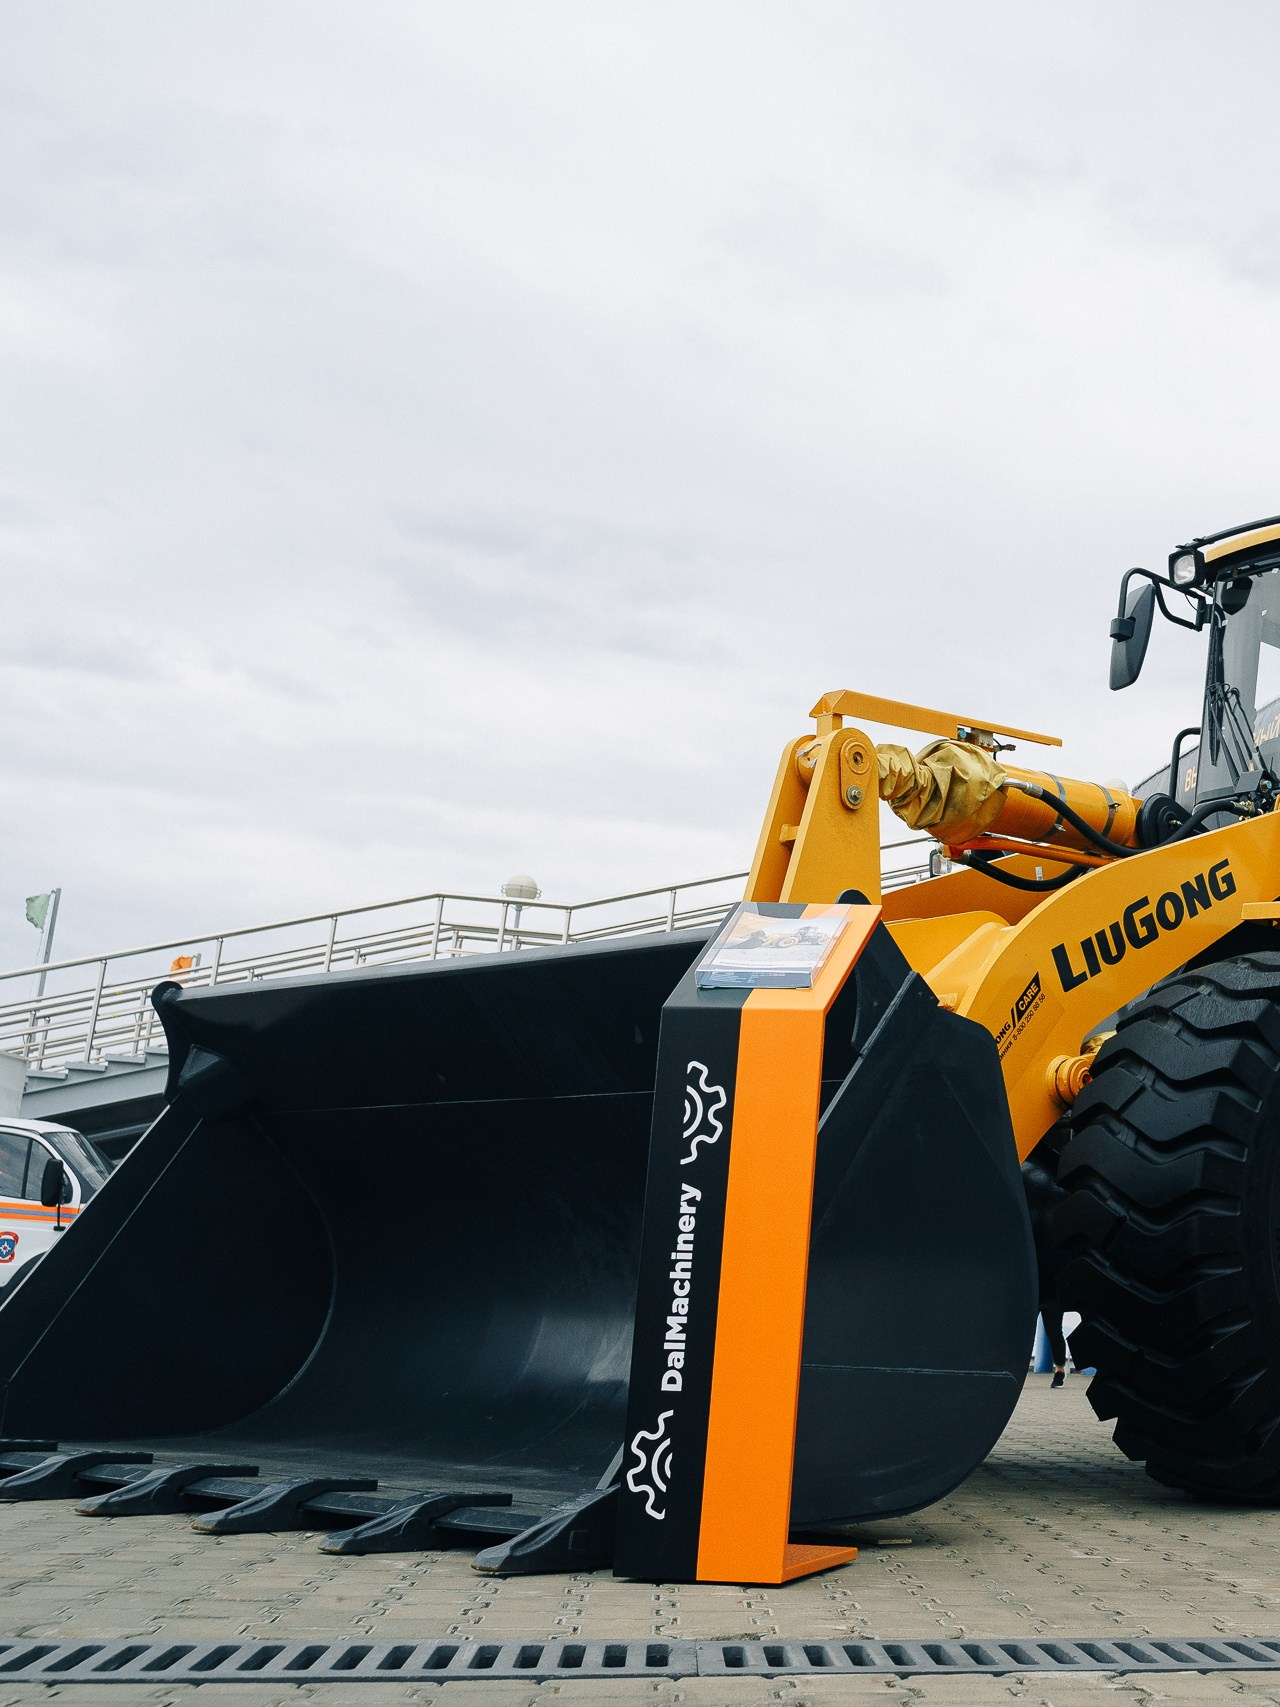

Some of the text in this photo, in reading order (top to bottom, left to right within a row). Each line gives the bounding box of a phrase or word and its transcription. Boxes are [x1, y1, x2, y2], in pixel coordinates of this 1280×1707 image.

[1018, 982, 1039, 1011] CARE
[1024, 1009, 1034, 1023] 250
[661, 1183, 702, 1392] DalMachinery
